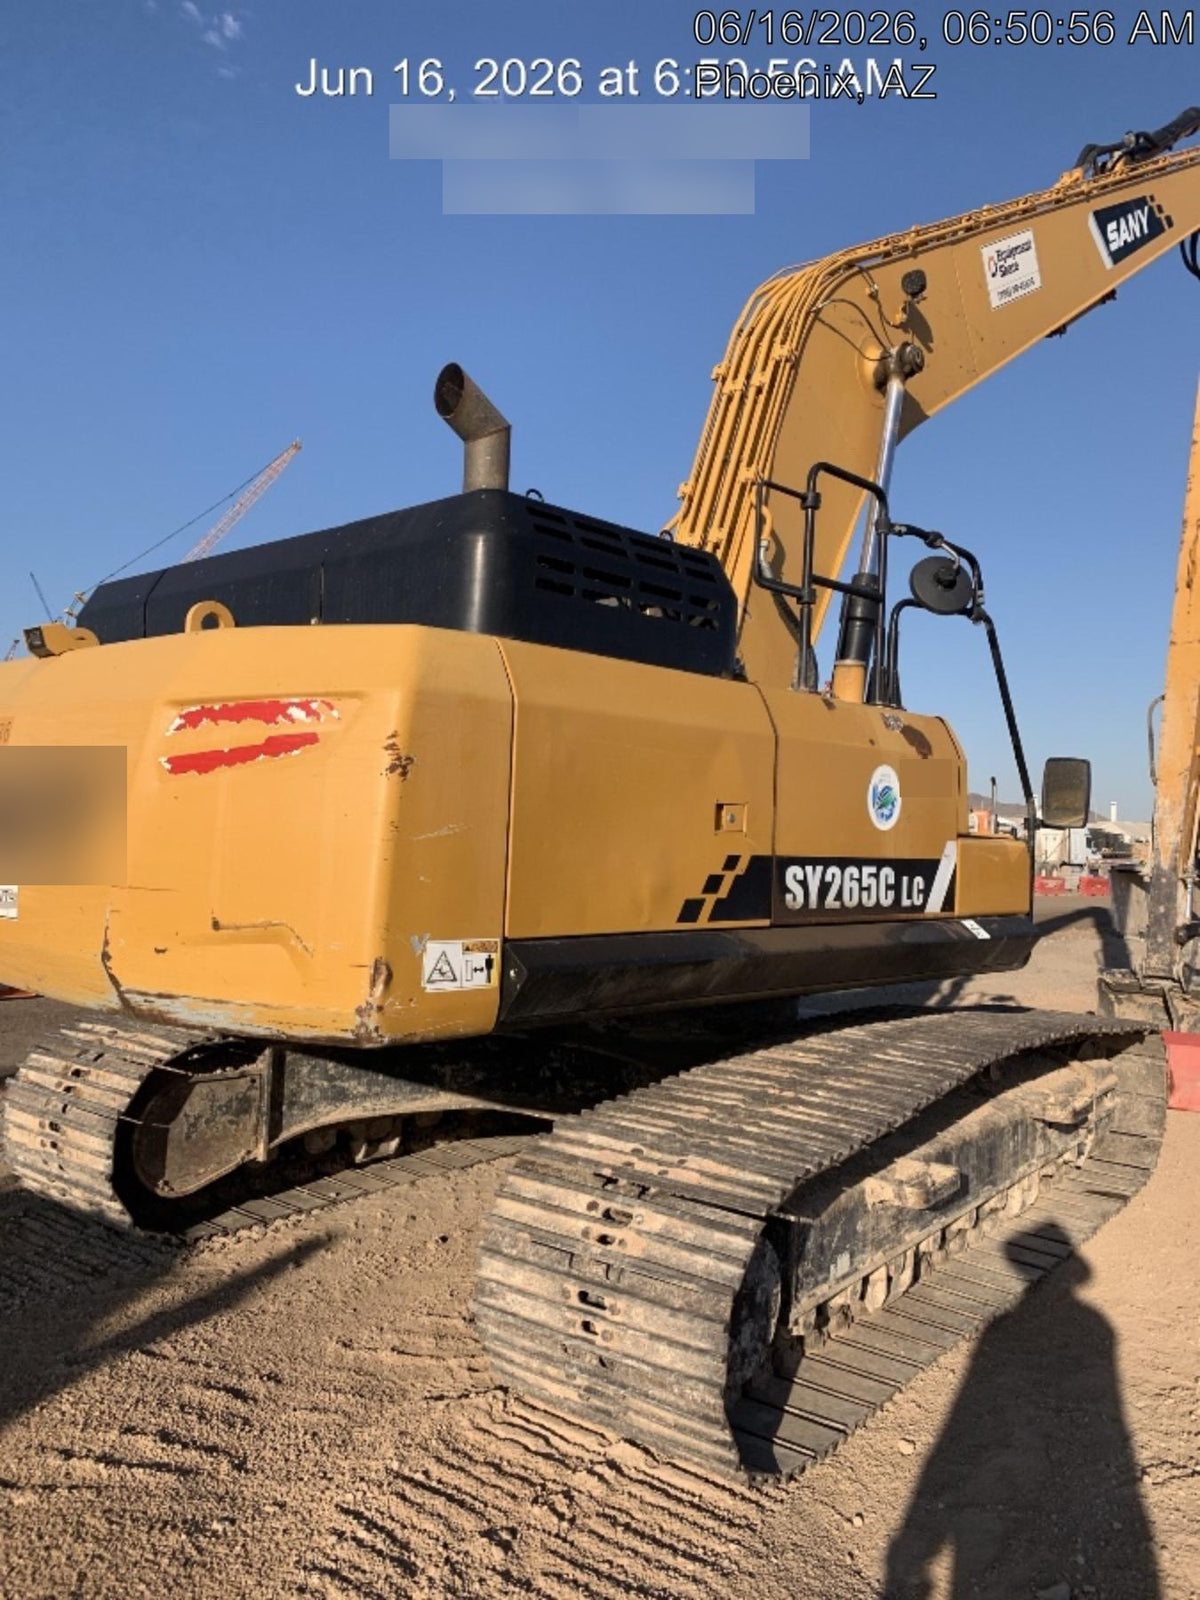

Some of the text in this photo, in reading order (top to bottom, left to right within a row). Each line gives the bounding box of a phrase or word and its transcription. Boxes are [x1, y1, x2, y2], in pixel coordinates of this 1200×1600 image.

[1107, 205, 1149, 252] SANY
[784, 865, 925, 911] SY265C LC
